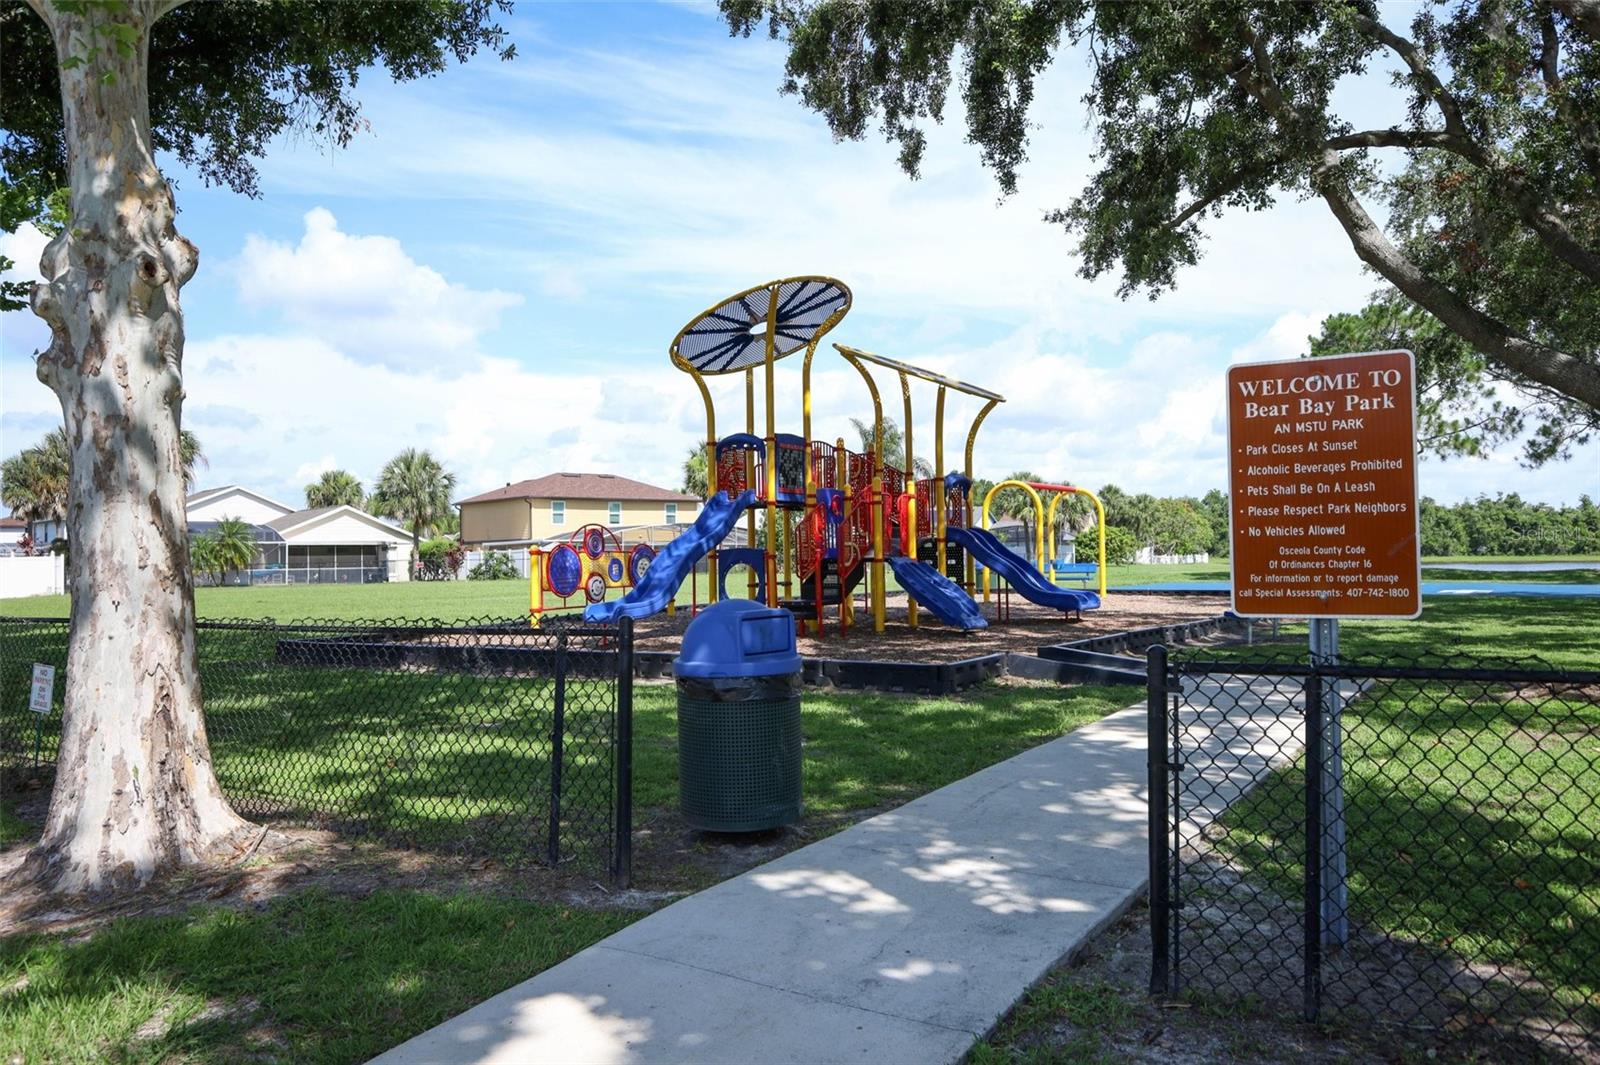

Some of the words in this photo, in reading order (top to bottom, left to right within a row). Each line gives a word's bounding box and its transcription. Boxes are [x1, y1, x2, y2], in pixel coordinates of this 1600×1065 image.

[1237, 373, 1361, 397] WELCOME
[1368, 369, 1402, 388] TO
[1245, 402, 1290, 419] Bear
[1298, 398, 1336, 417] Bay
[1345, 392, 1395, 412] Park
[1273, 423, 1291, 435] AN
[1295, 420, 1327, 433] MSTU
[1332, 417, 1364, 431] PARK
[1246, 444, 1268, 456] Park
[1271, 443, 1304, 455] Closes
[1307, 441, 1319, 453] At
[1322, 439, 1358, 452] Sunset
[1247, 463, 1290, 476] Alcoholic
[1294, 463, 1346, 475] Beverages
[1350, 458, 1403, 471] Prohibited
[1247, 485, 1269, 496] Pets
[1272, 484, 1296, 496] Shall
[1300, 483, 1313, 494] Be
[1316, 482, 1330, 494] On
[1333, 482, 1341, 493] A
[1345, 481, 1376, 493] Leash
[1247, 505, 1280, 517] Please
[1283, 504, 1324, 517] Respect
[1327, 503, 1351, 514] Park
[1354, 502, 1407, 516] Neighbors
[1248, 526, 1261, 537] No
[1264, 526, 1305, 537] Vehicles
[1308, 524, 1346, 536] Allowed
[1279, 546, 1311, 556] Osceola
[1313, 545, 1342, 556] County
[1345, 545, 1366, 555] Code
[1269, 560, 1279, 569] Of
[1280, 560, 1325, 569] Ordinances
[1328, 559, 1361, 571] Chapter
[1363, 559, 1373, 568] 16
[1250, 574, 1262, 583] For
[1265, 574, 1311, 583] information
[1313, 575, 1322, 583] or
[1325, 574, 1334, 583] to
[1337, 574, 1363, 584] report
[1366, 574, 1399, 585] damage
[1239, 588, 1253, 598] call
[1255, 588, 1284, 600] Special
[1346, 588, 1410, 598] 407-742-1800
